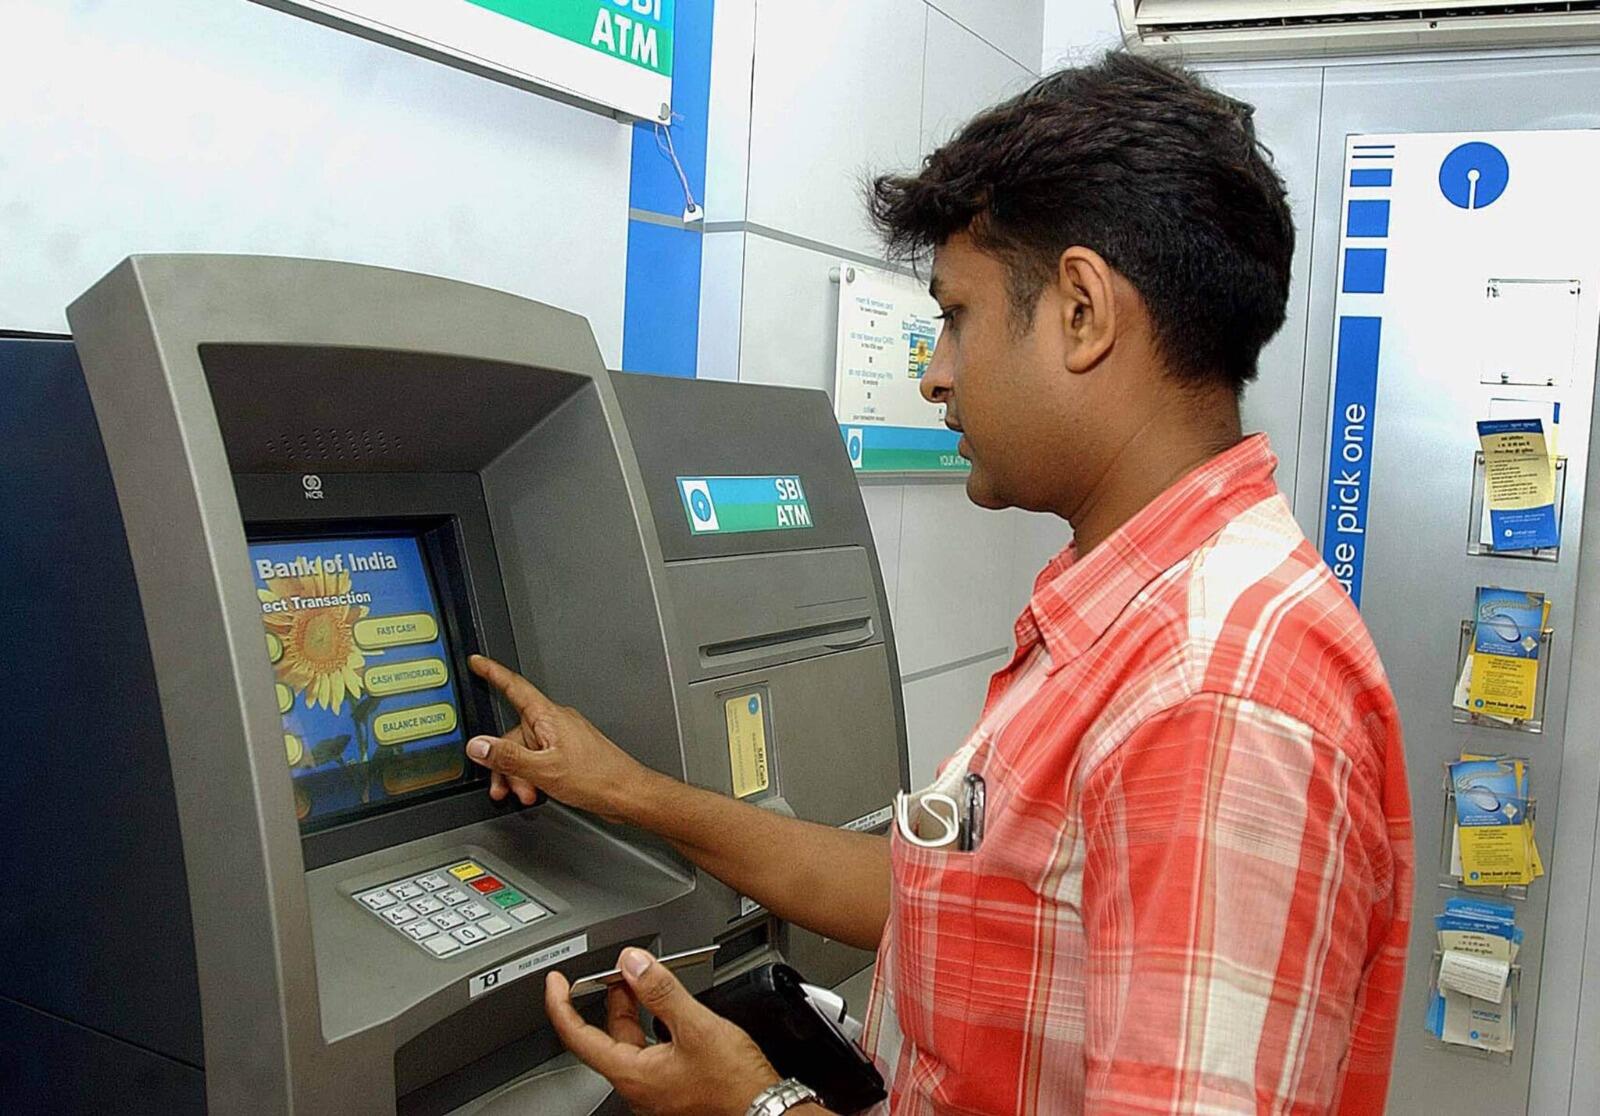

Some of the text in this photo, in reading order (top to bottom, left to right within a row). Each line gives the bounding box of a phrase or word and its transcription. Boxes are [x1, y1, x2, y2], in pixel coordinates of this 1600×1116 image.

[590, 7, 658, 68] ATM
[1342, 403, 1367, 462] one
[304, 490, 324, 500] NCR
[775, 478, 803, 501] SBI
[1331, 470, 1365, 533] pick
[776, 504, 810, 527] ATM
[255, 551, 398, 580] Bank of India
[262, 591, 372, 613] ect Transaction
[376, 623, 417, 636] FAST CASH
[370, 666, 441, 686] CASH WITHDRAWAL
[382, 711, 447, 733] BALANCE INQUIRY
[370, 898, 381, 906] 1
[396, 889, 410, 898] 2
[392, 912, 404, 920] 4
[416, 903, 430, 911] 5
[409, 927, 422, 936] 7
[462, 929, 476, 938] 0
